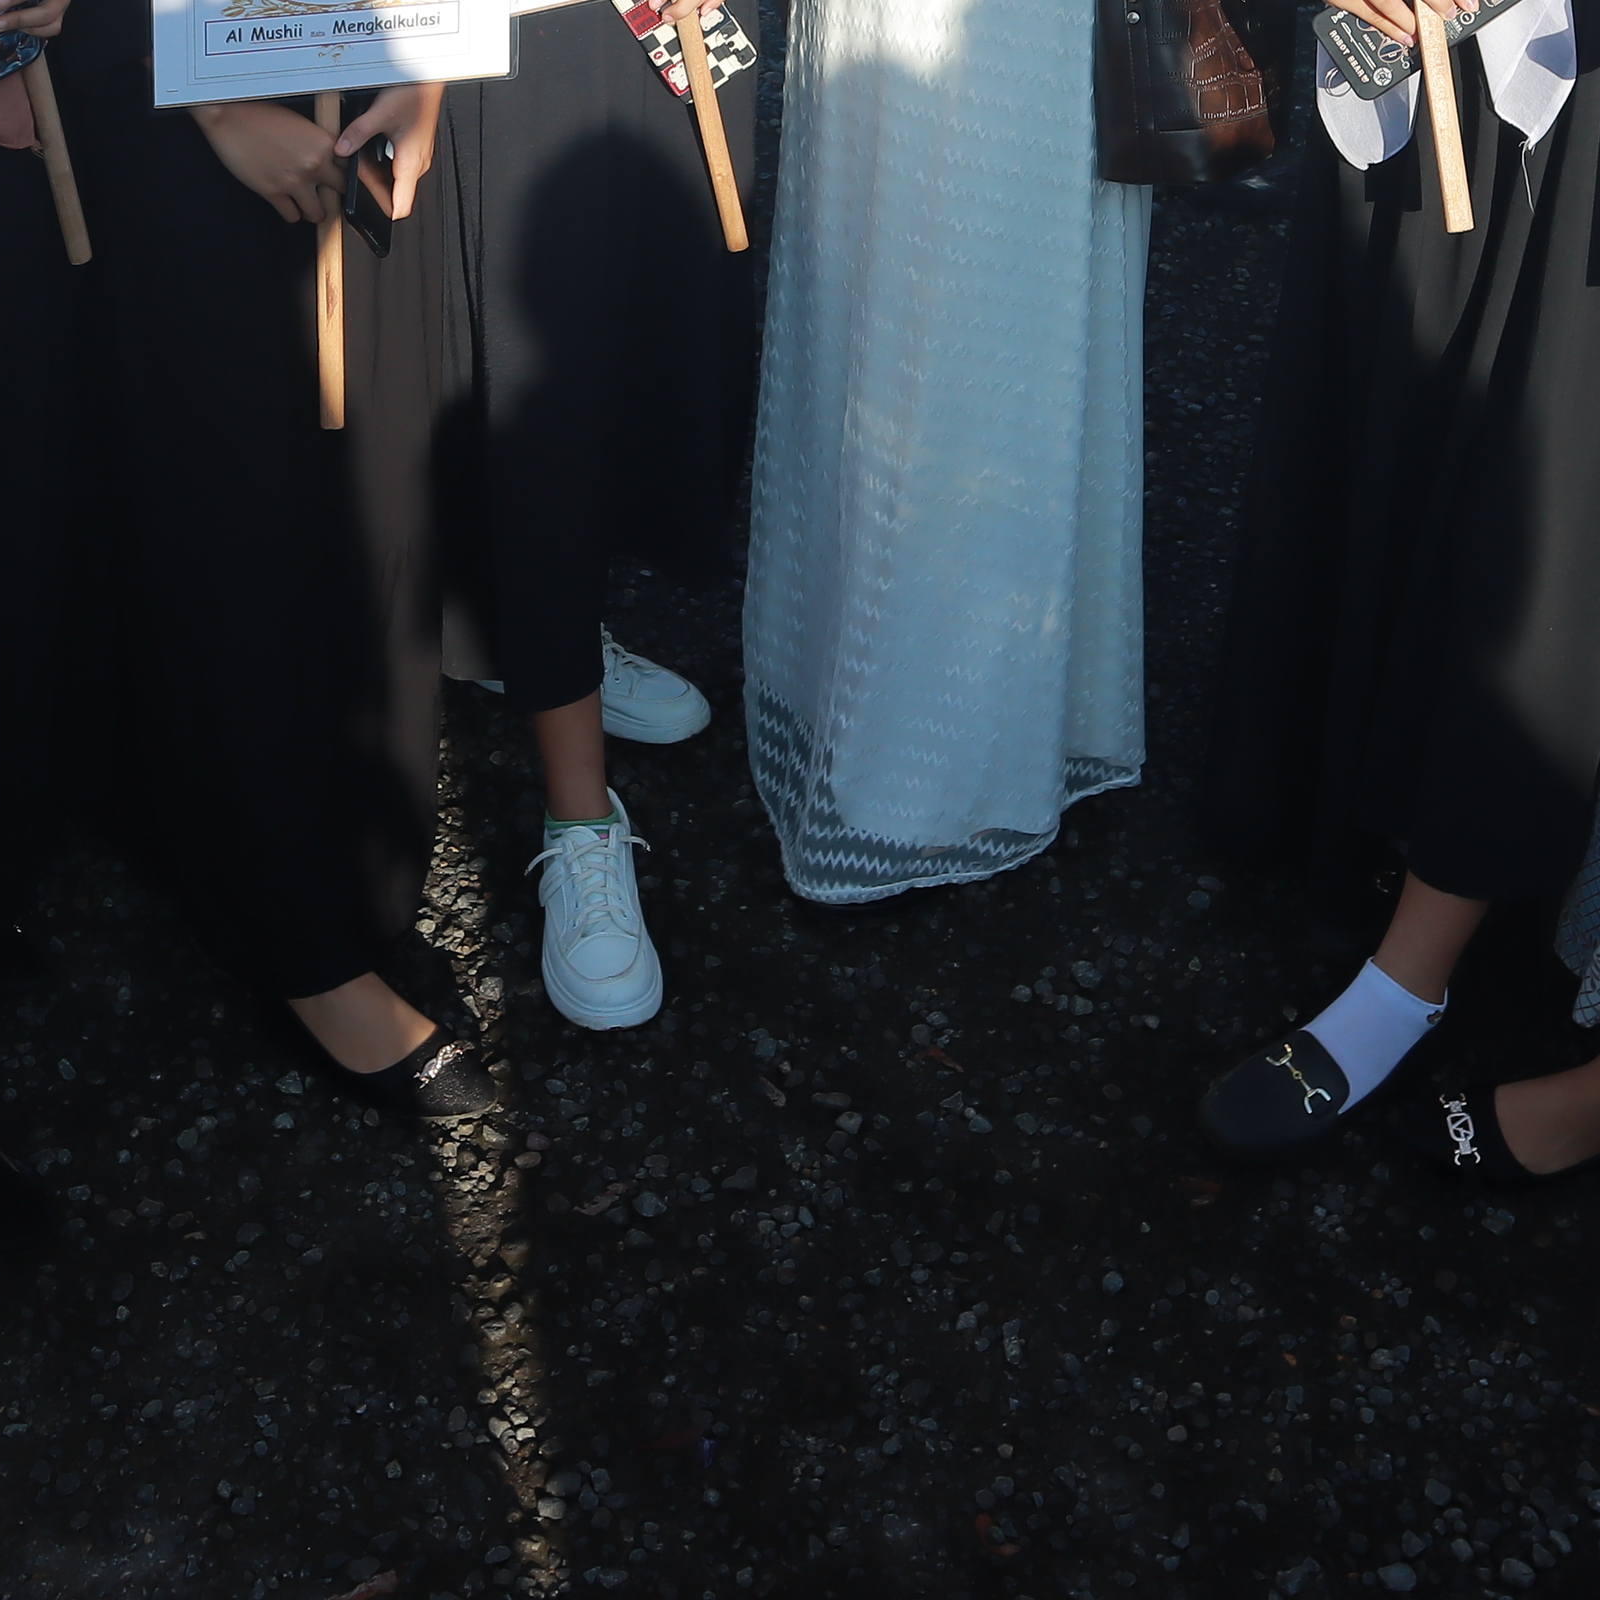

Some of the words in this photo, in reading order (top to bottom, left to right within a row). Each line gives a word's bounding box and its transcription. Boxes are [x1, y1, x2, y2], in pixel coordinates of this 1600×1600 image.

[225, 28, 243, 45] Al
[250, 23, 303, 42] Mushii
[331, 11, 442, 37] Mengkalkulasi
[1362, 33, 1377, 52] REPAIR
[1329, 30, 1351, 56] ROBOT
[1347, 55, 1366, 79] BEAR
